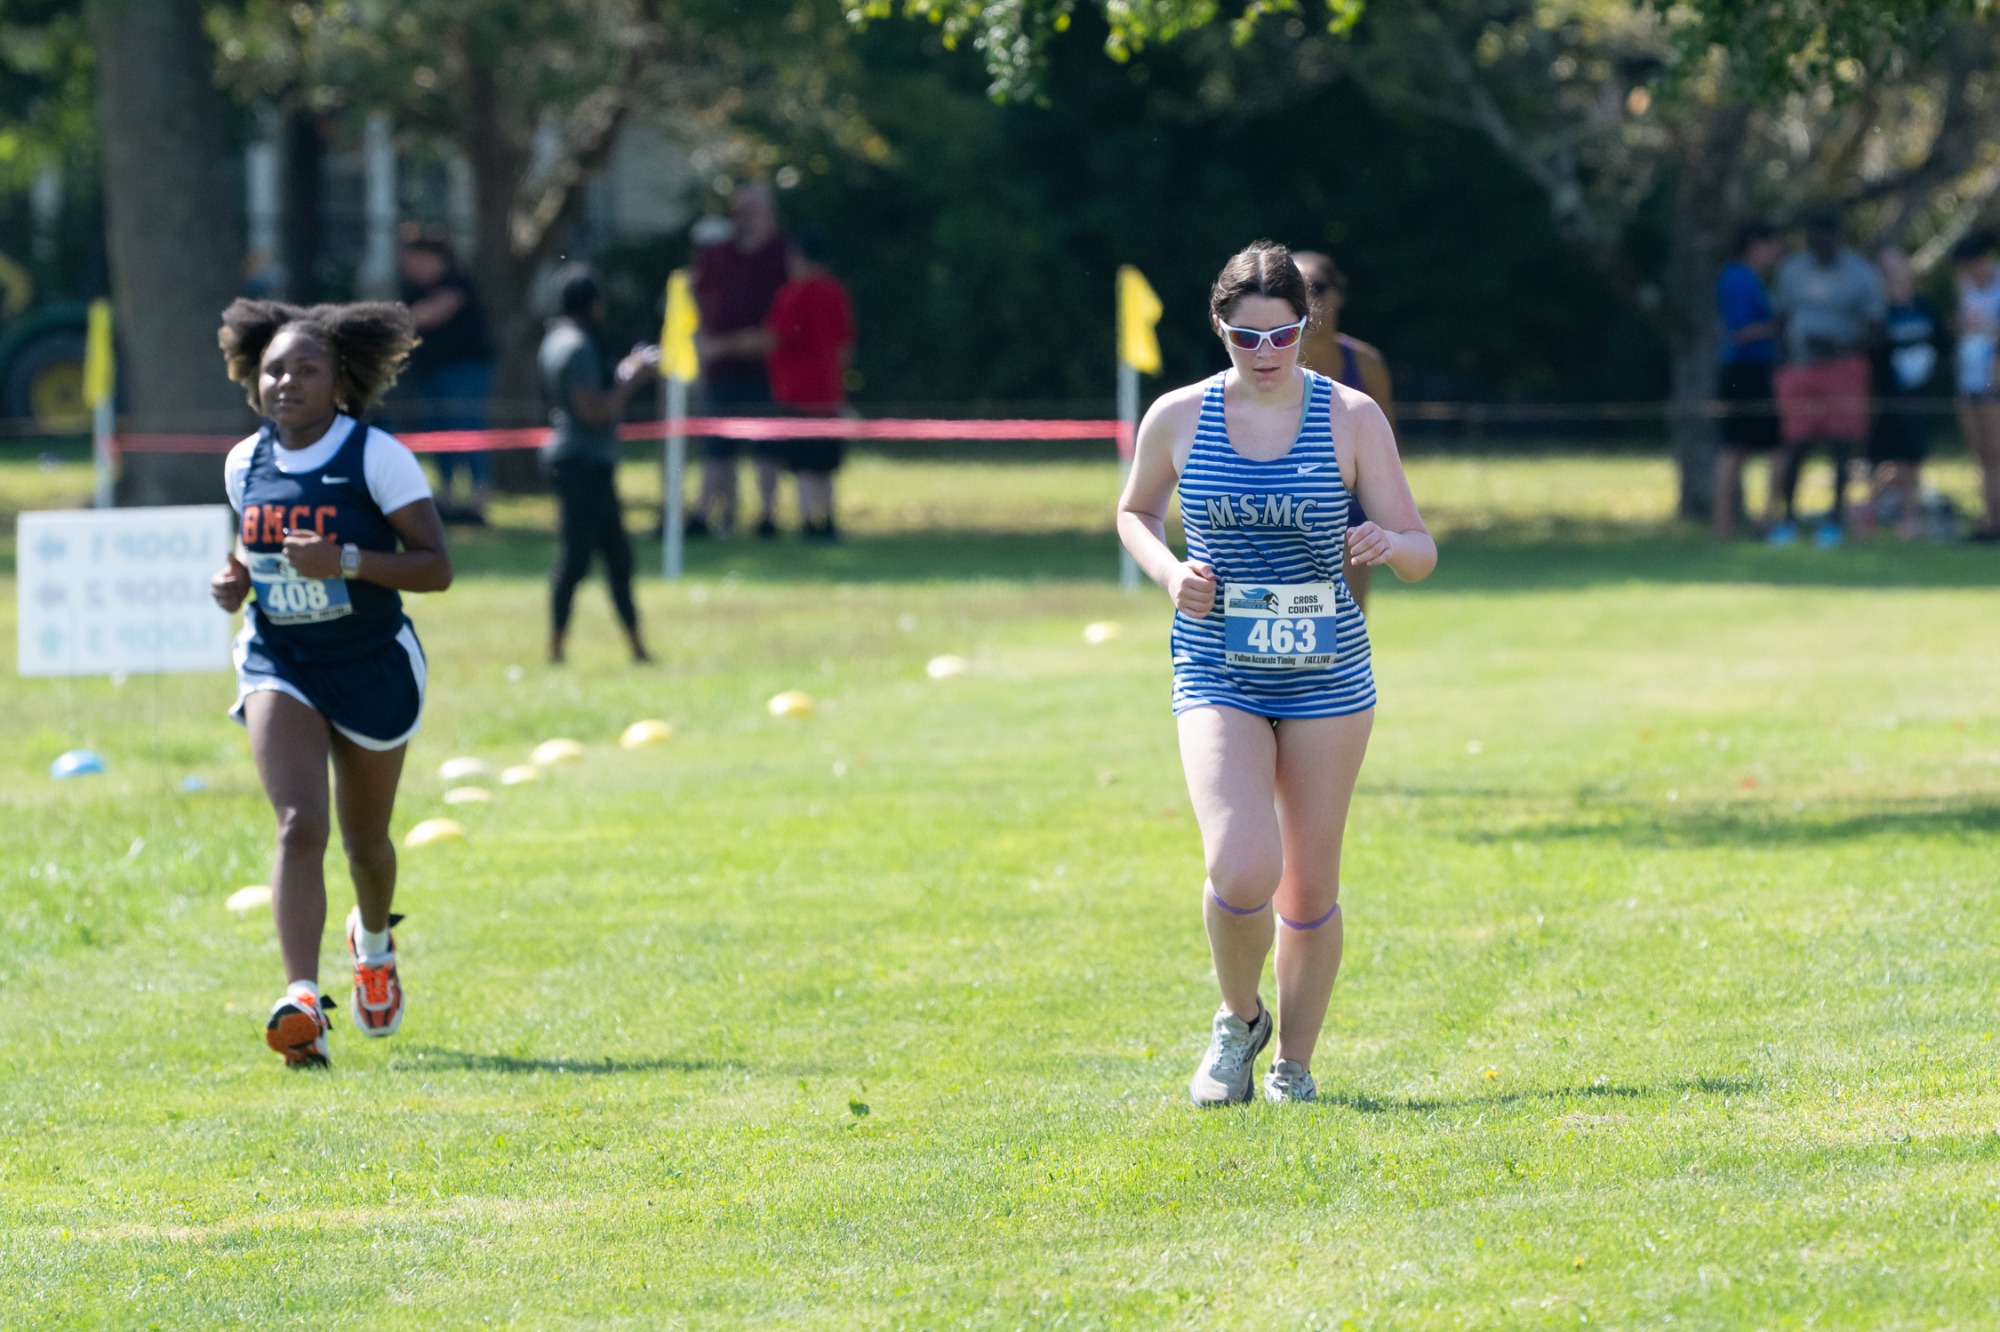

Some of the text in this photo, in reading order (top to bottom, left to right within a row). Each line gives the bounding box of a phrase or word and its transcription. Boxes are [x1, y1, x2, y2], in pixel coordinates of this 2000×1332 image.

[243, 504, 337, 544] BMCC
[1205, 493, 1318, 532] MSMC
[268, 580, 329, 612] 408
[1288, 605, 1323, 614] COUNTRY
[1293, 595, 1318, 605] CROSS
[1247, 618, 1317, 654] 463
[1234, 653, 1251, 662] Fulton
[1252, 655, 1276, 664] Accurate
[1277, 656, 1296, 665] Timing
